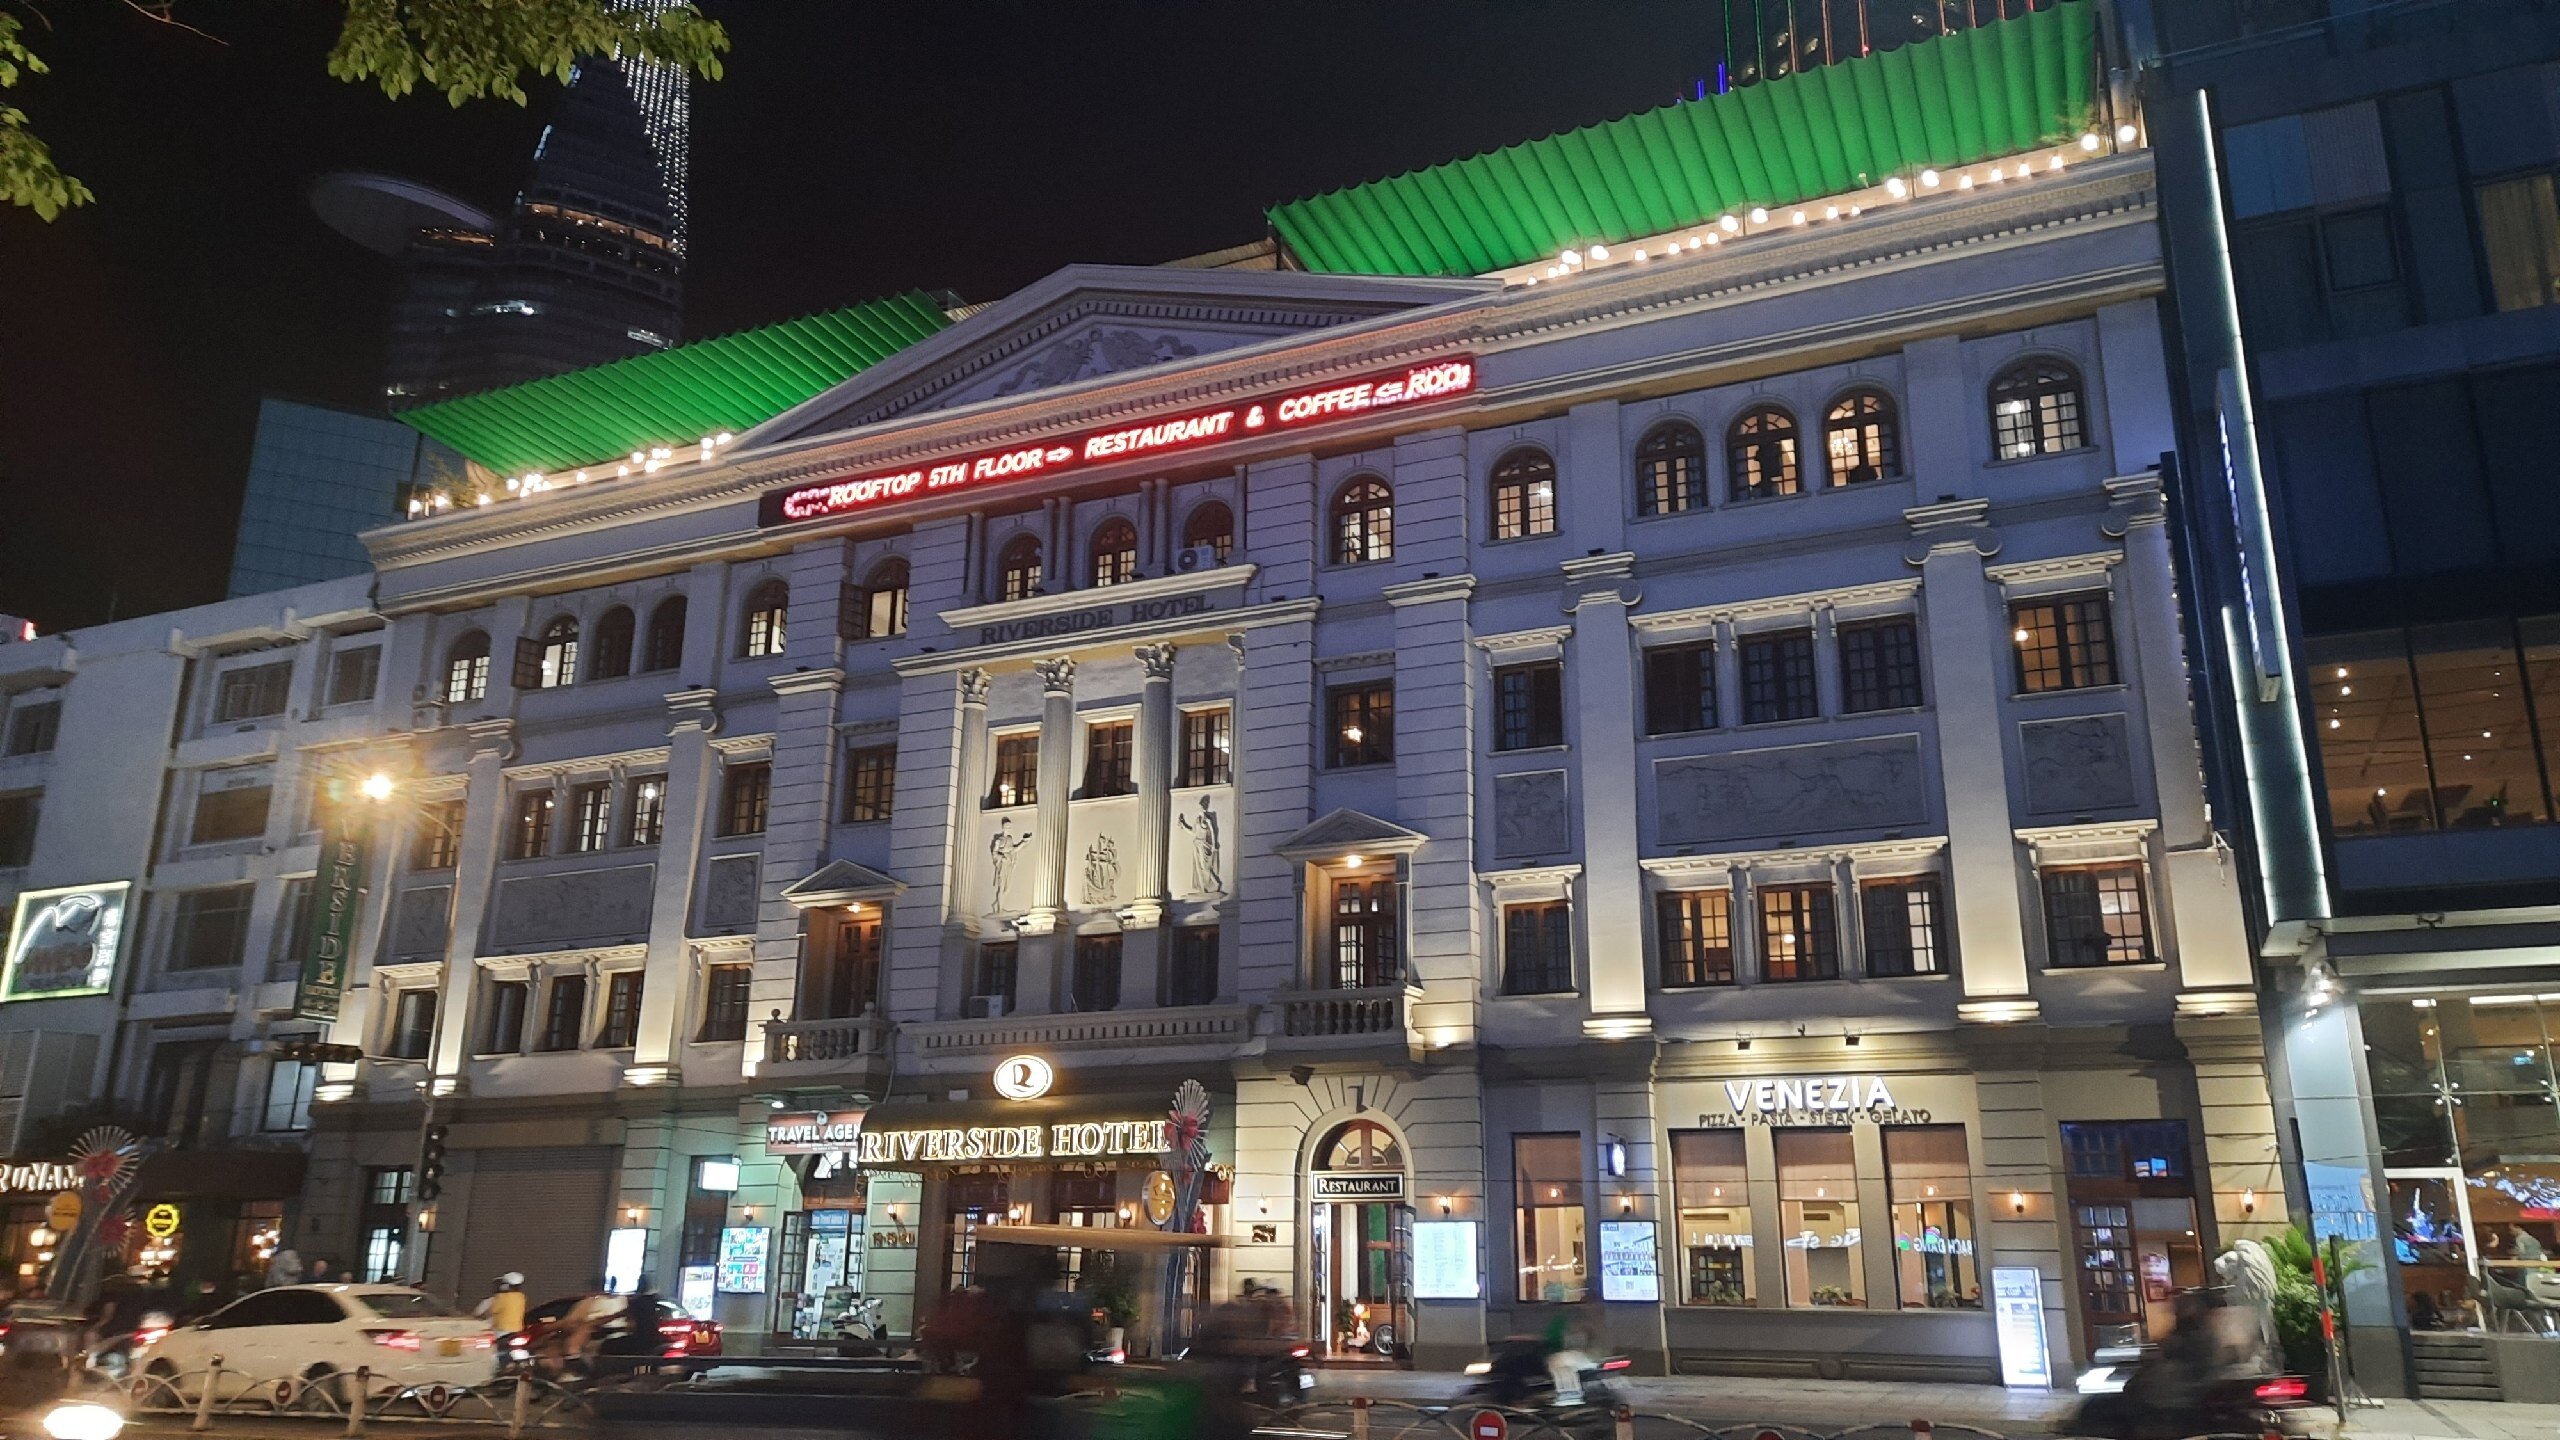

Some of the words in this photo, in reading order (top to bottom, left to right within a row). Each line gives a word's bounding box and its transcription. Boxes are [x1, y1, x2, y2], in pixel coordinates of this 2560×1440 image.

[1084, 409, 1234, 459] RESTAURANT
[1245, 404, 1266, 428] &
[1278, 382, 1373, 421] COFFEE
[827, 471, 921, 506] ROOFTOP
[928, 463, 966, 487] 5TH
[973, 447, 1044, 480] FLOOR
[980, 610, 1113, 644] RIVERSIDE
[1131, 595, 1214, 622] HOTEL
[1725, 1076, 1896, 1112] VENEZIA
[768, 1125, 820, 1143] TRAVEL
[1699, 1113, 1737, 1127] PIZZA
[1751, 1111, 1796, 1126] PASTA
[1809, 1110, 1855, 1126] STEAK
[1869, 1109, 1932, 1125] GELATO
[859, 1126, 1043, 1162] RIVERSIDE
[1050, 1120, 1170, 1156] HOTEL
